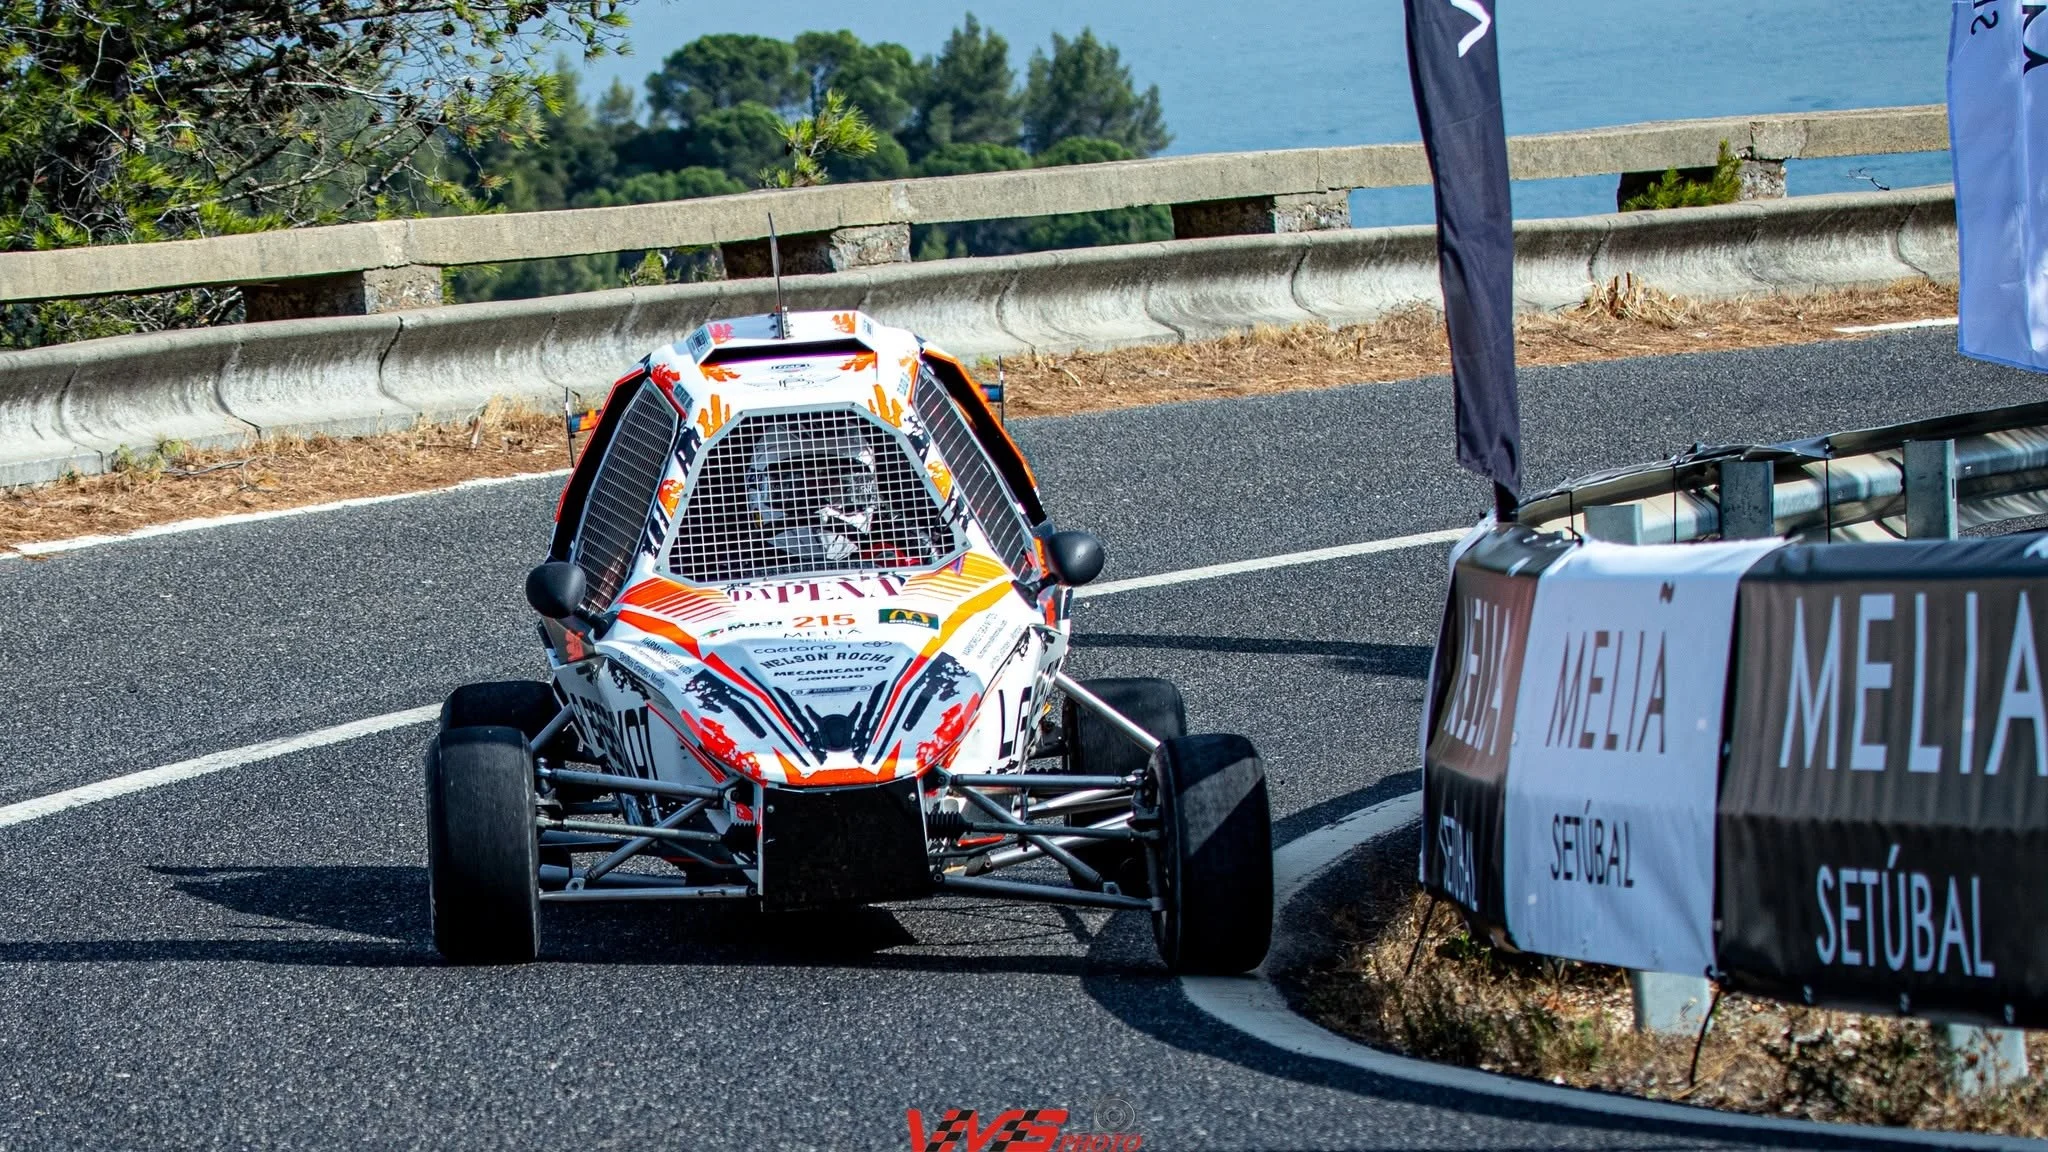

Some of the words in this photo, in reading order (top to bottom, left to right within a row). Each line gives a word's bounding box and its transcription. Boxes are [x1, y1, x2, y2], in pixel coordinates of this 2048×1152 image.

[793, 613, 857, 628] 215
[753, 644, 837, 654] caetano
[760, 653, 828, 669] NELSON
[835, 651, 896, 664] ROCHA
[773, 666, 887, 676] MECANICAUTO
[1550, 800, 1635, 888] SETÚBAL
[1816, 844, 1995, 979] SETÚBAL
